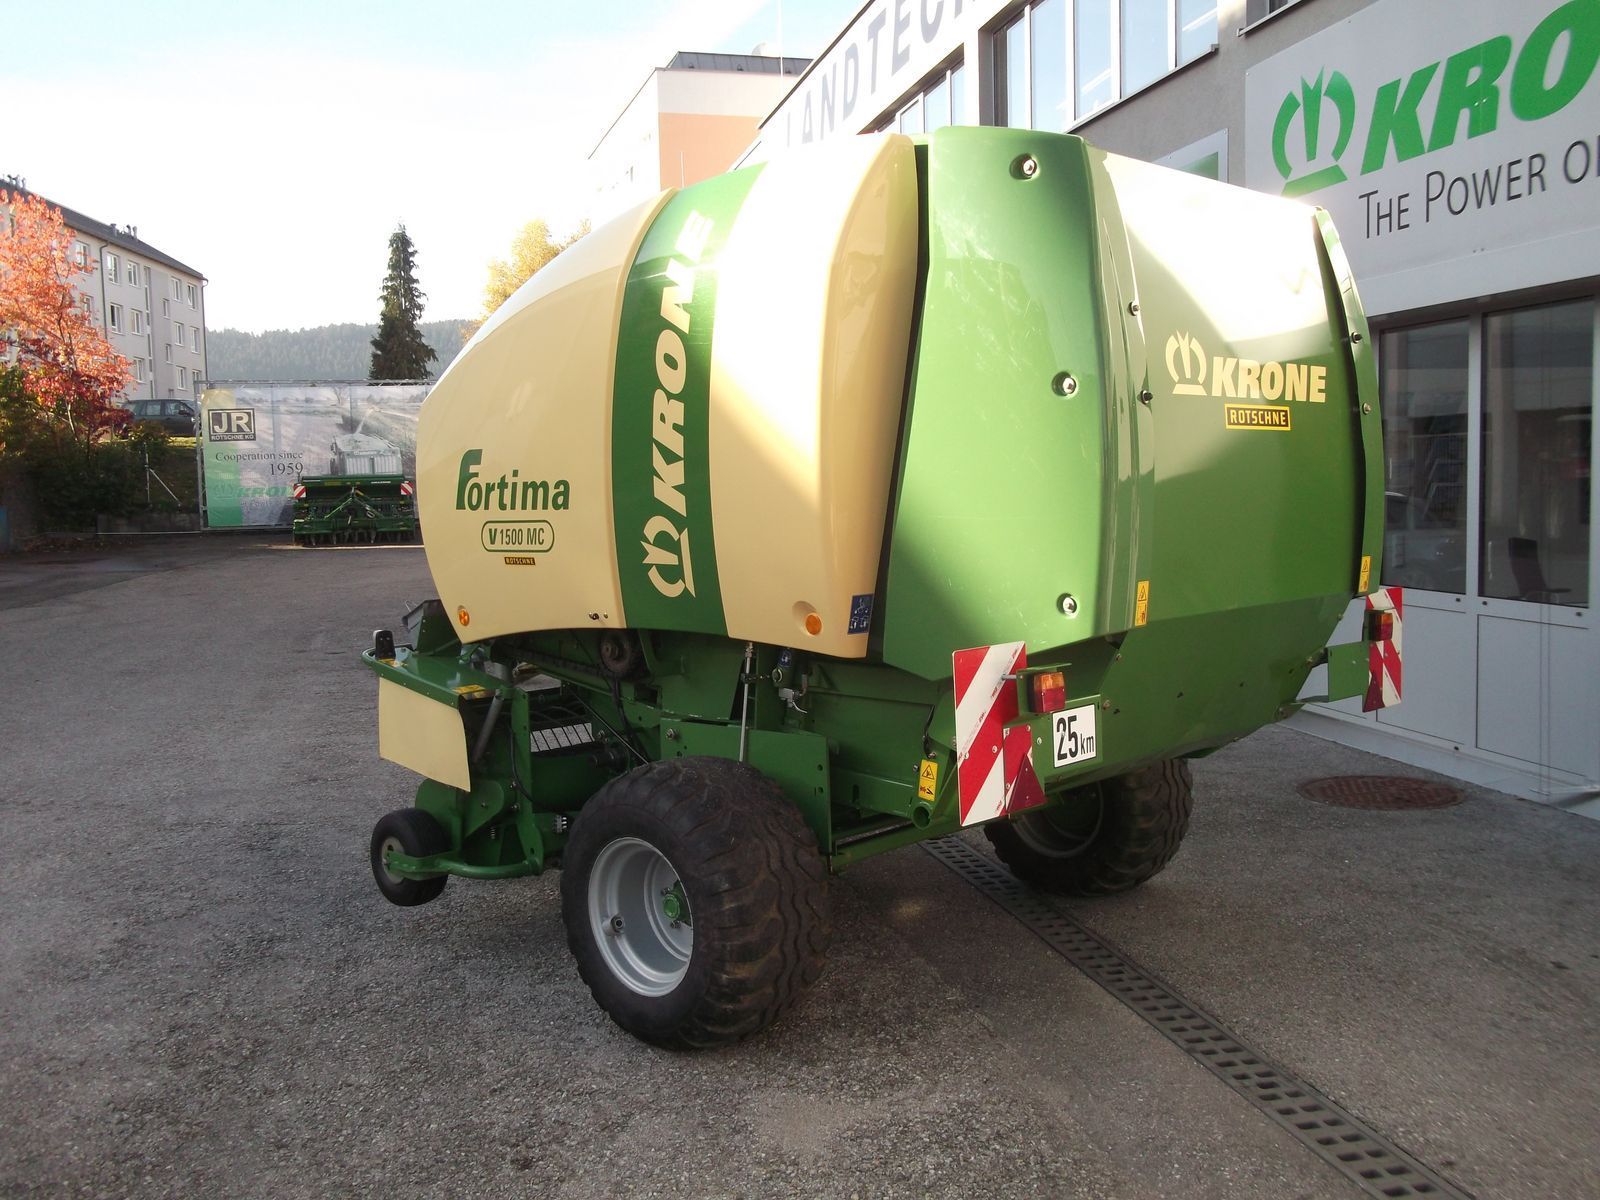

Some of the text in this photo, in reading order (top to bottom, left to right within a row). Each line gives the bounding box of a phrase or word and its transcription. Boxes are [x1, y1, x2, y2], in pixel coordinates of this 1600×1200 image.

[1359, 134, 1600, 239] THE POWER O
[652, 208, 715, 518] KRONE
[1211, 356, 1327, 403] KRONE
[213, 412, 252, 433] JR
[1230, 409, 1287, 426] ROTSCHNE
[215, 450, 303, 463] Cooperation since
[270, 462, 303, 476] 1959
[456, 448, 570, 511] Fortima
[526, 527, 545, 545] MC
[1056, 715, 1095, 761] 25 km
